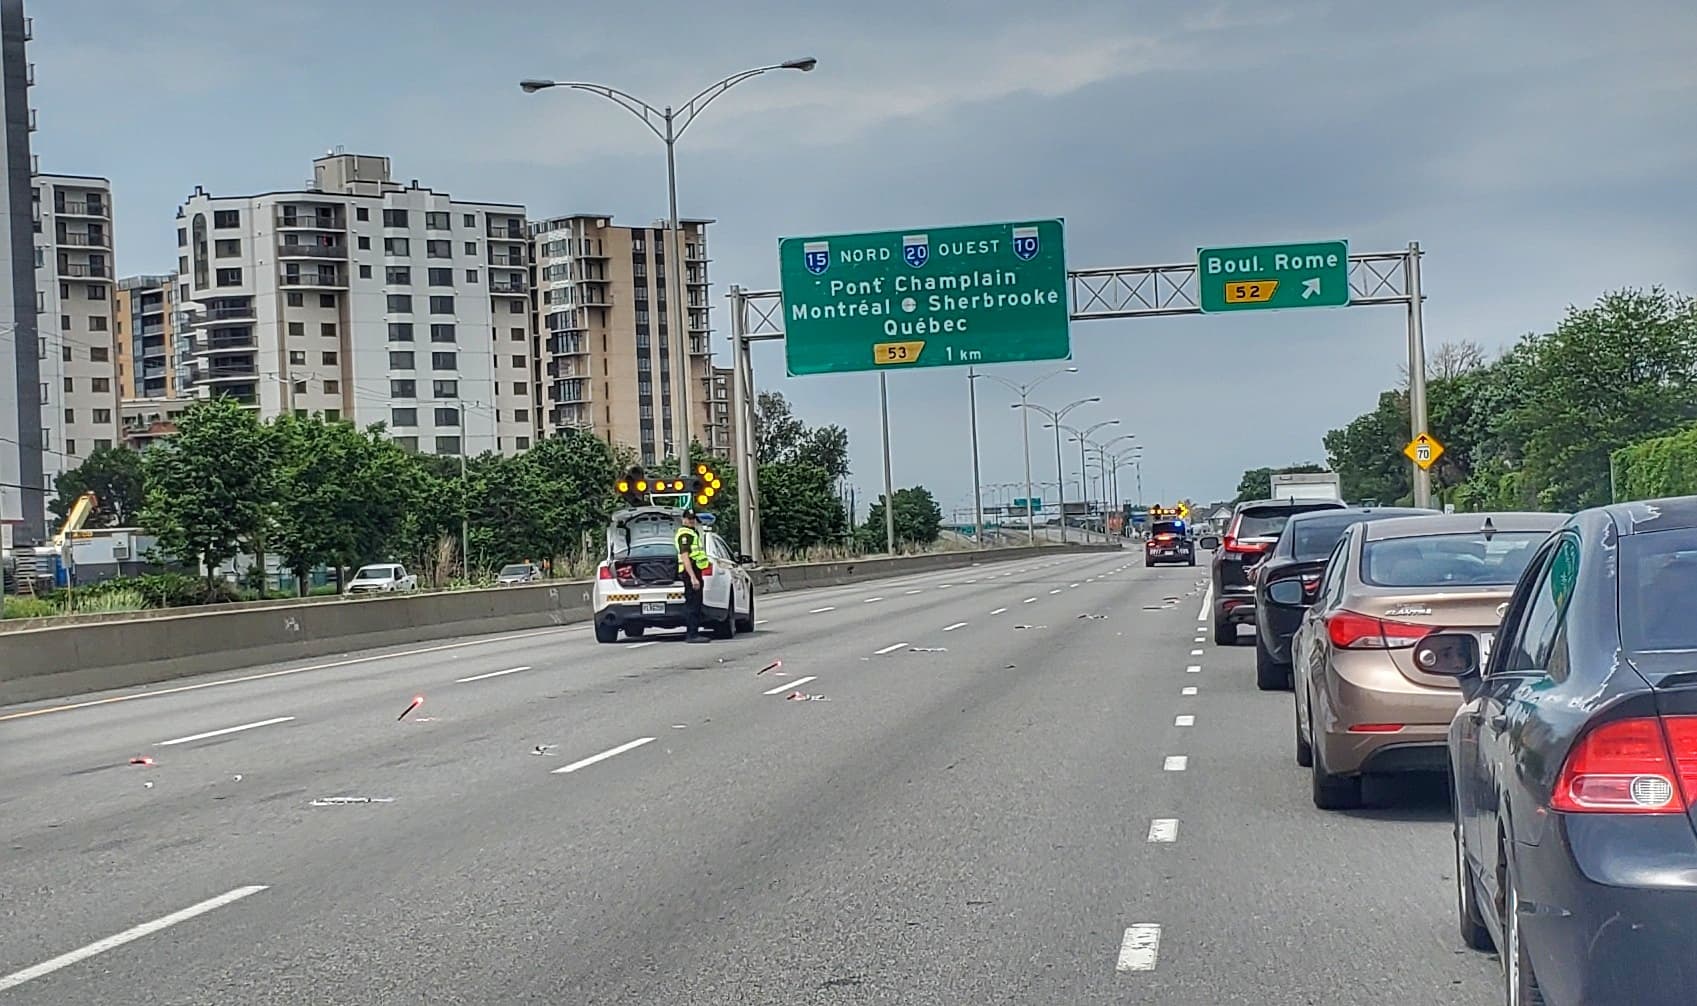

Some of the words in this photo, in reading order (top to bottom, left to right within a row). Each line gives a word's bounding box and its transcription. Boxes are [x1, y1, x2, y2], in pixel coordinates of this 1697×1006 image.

[807, 253, 826, 266] 15
[840, 248, 890, 263] NORD
[906, 247, 926, 260] 20
[938, 240, 999, 256] OUEST
[1015, 238, 1035, 252] 10
[1208, 255, 1264, 274] Boul.
[1275, 254, 1338, 270] Rome
[831, 278, 882, 296] Pont
[895, 270, 1016, 292] Champlain
[1236, 286, 1260, 298] 52
[792, 299, 890, 320] Montréal
[929, 289, 1058, 312] Sherbrooke
[884, 317, 967, 336] Québec
[888, 346, 907, 359] 53
[946, 347, 952, 361] 1
[960, 348, 981, 360] km
[1418, 450, 1429, 459] 70
